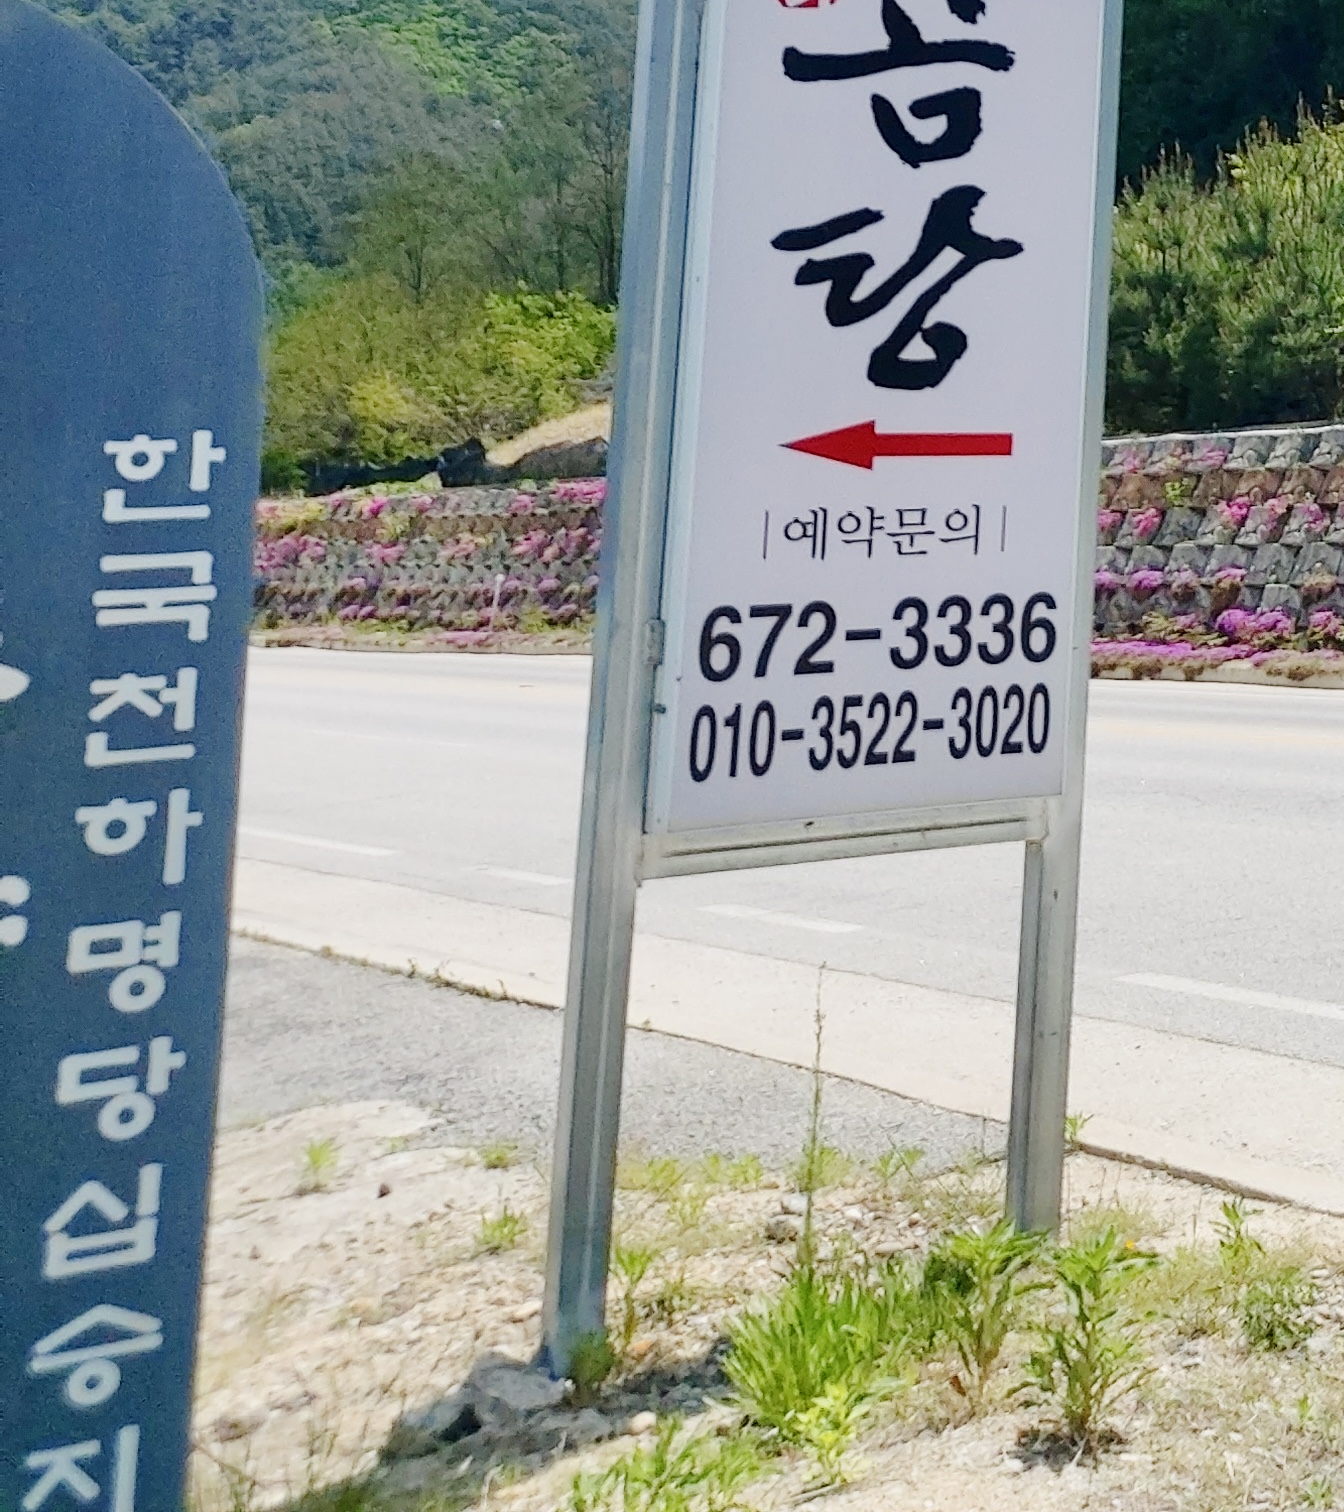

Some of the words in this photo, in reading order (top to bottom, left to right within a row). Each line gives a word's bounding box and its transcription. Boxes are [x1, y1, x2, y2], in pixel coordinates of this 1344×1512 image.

[783, 503, 980, 560] 예약문의
[698, 591, 1057, 682] 672-3336
[688, 682, 1051, 782] 010-3522-3020
